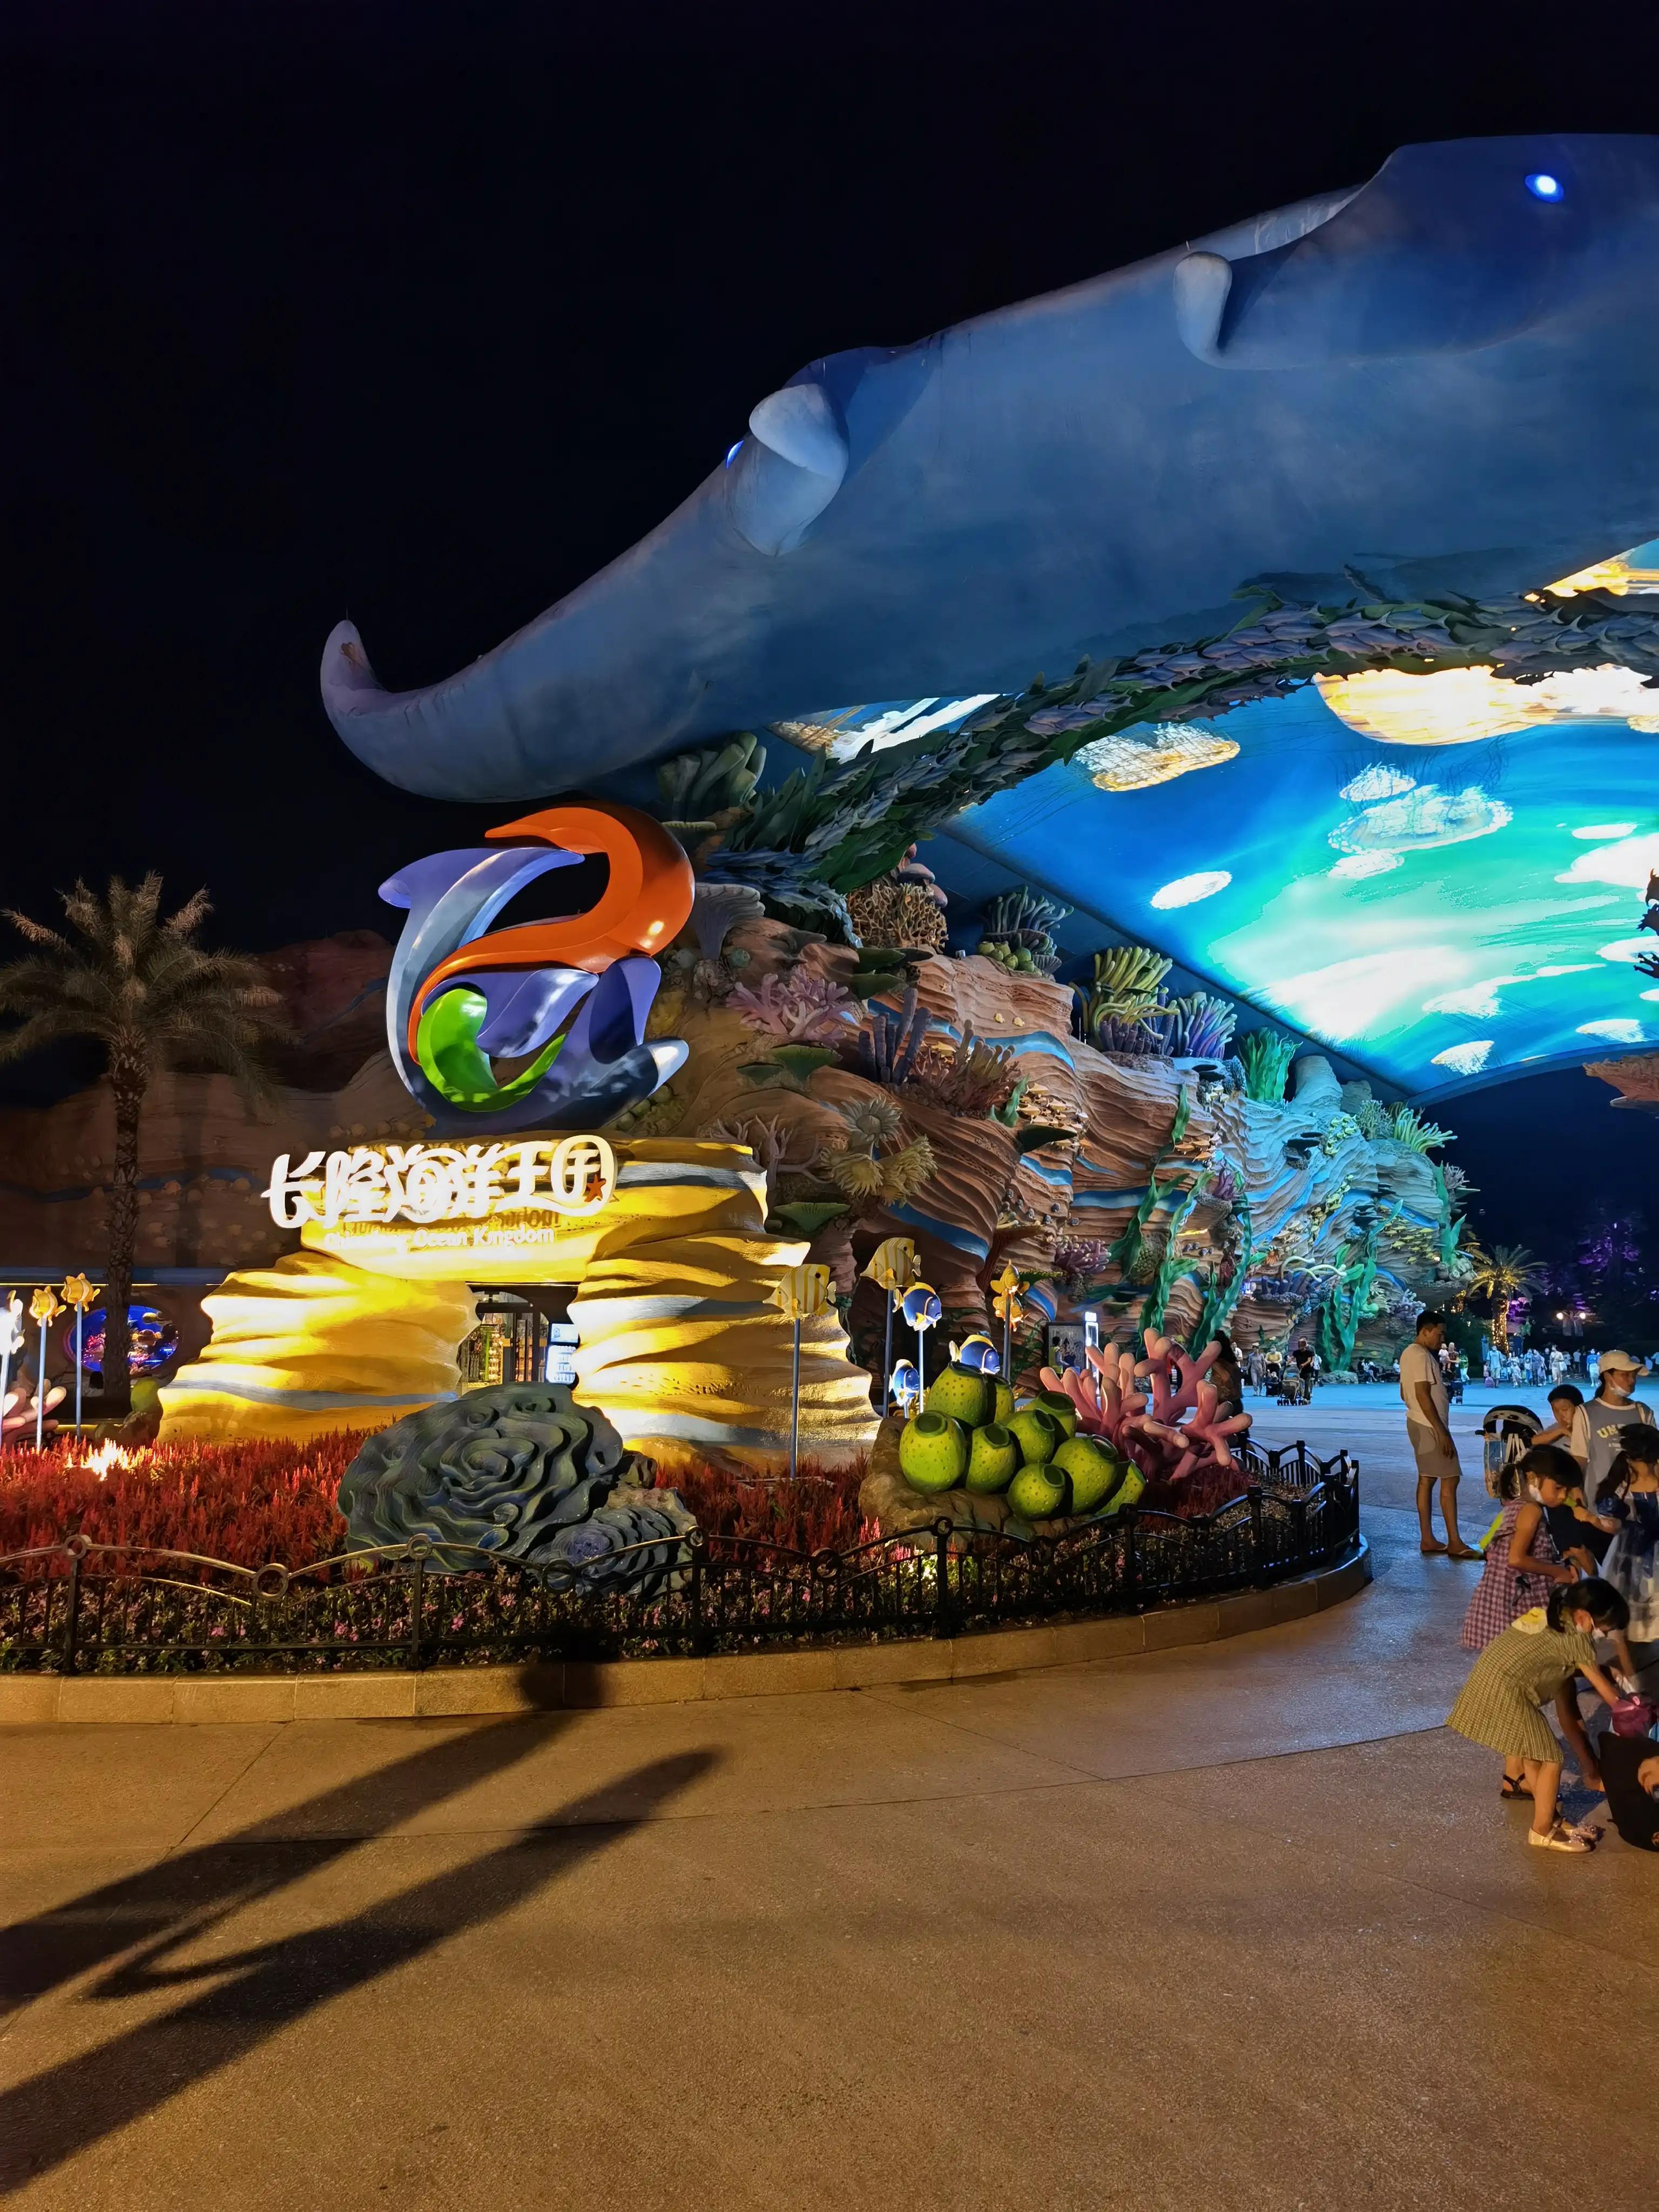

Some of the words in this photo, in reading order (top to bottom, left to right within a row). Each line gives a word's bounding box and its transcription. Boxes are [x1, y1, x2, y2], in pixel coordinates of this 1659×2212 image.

[260, 1135, 615, 1229] 长隆海洋王国
[414, 1228, 468, 1249] Ocean
[473, 1219, 555, 1249] Kingdom
[1596, 1424, 1626, 1439] UN
